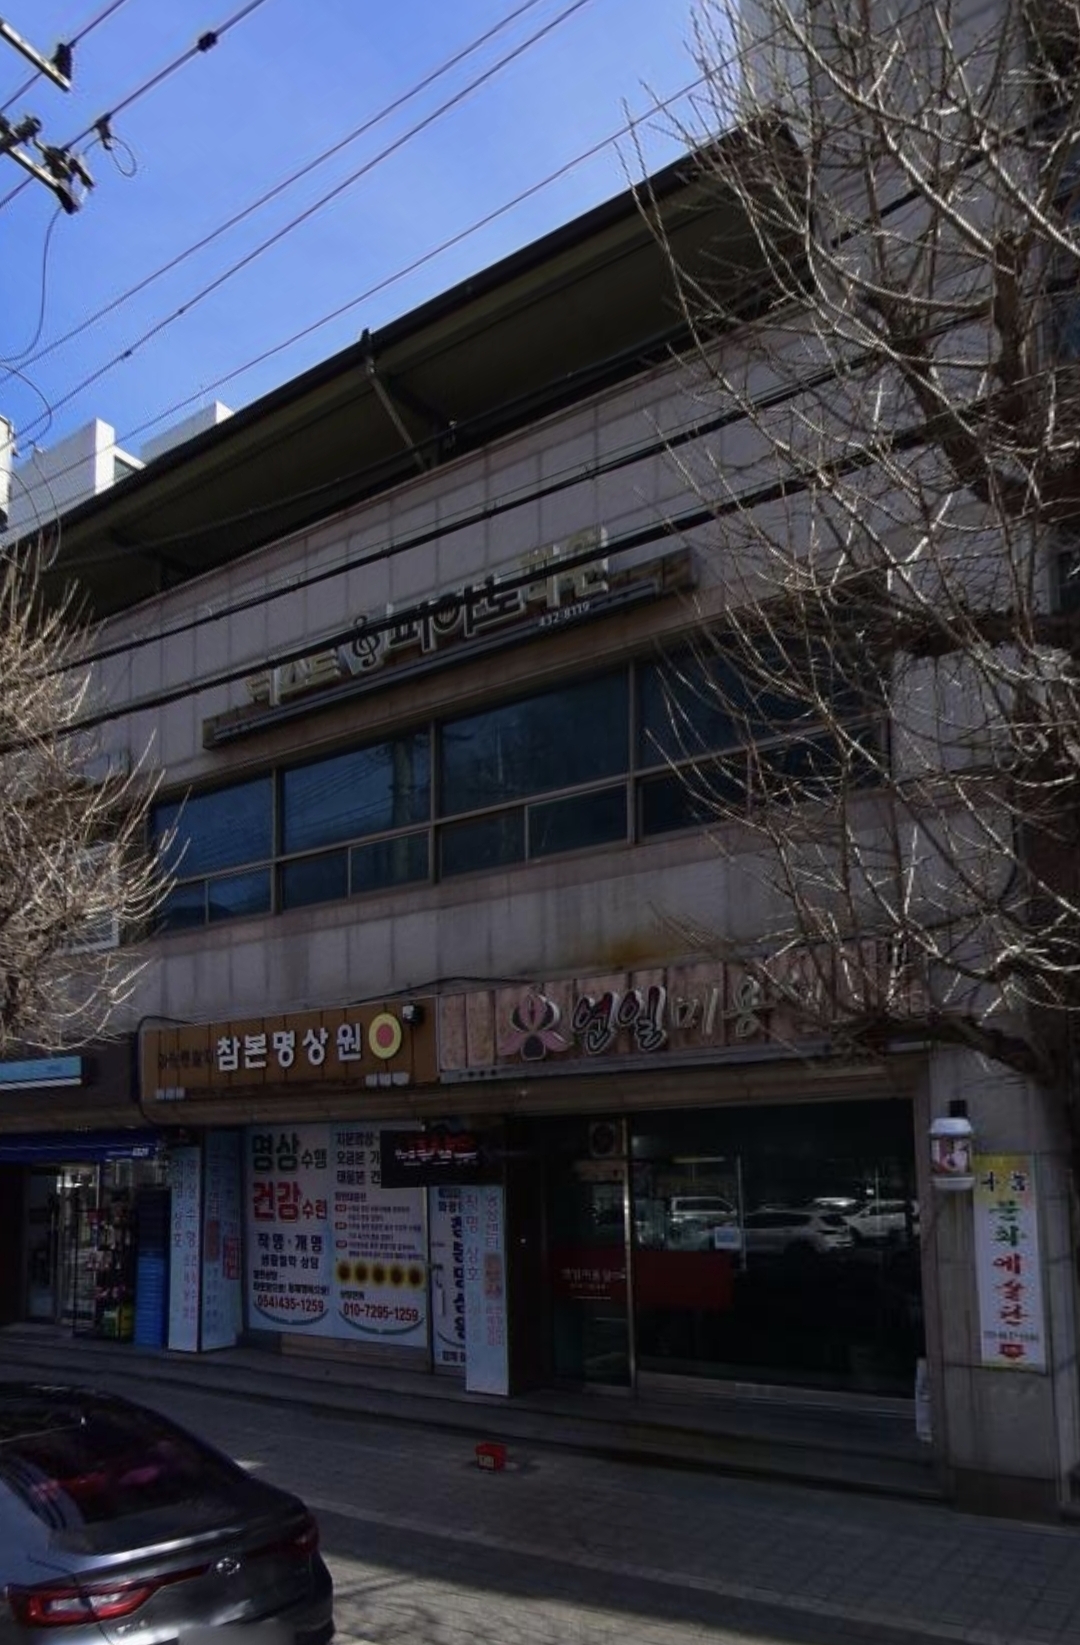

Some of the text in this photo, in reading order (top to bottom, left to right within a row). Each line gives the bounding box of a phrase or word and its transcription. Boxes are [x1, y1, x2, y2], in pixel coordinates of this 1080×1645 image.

[216, 1022, 362, 1072] 참본명상원
[252, 1131, 300, 1172] 명상
[253, 1181, 302, 1222] 건강
[302, 1198, 327, 1220] 수련
[301, 1255, 319, 1270] 상담
